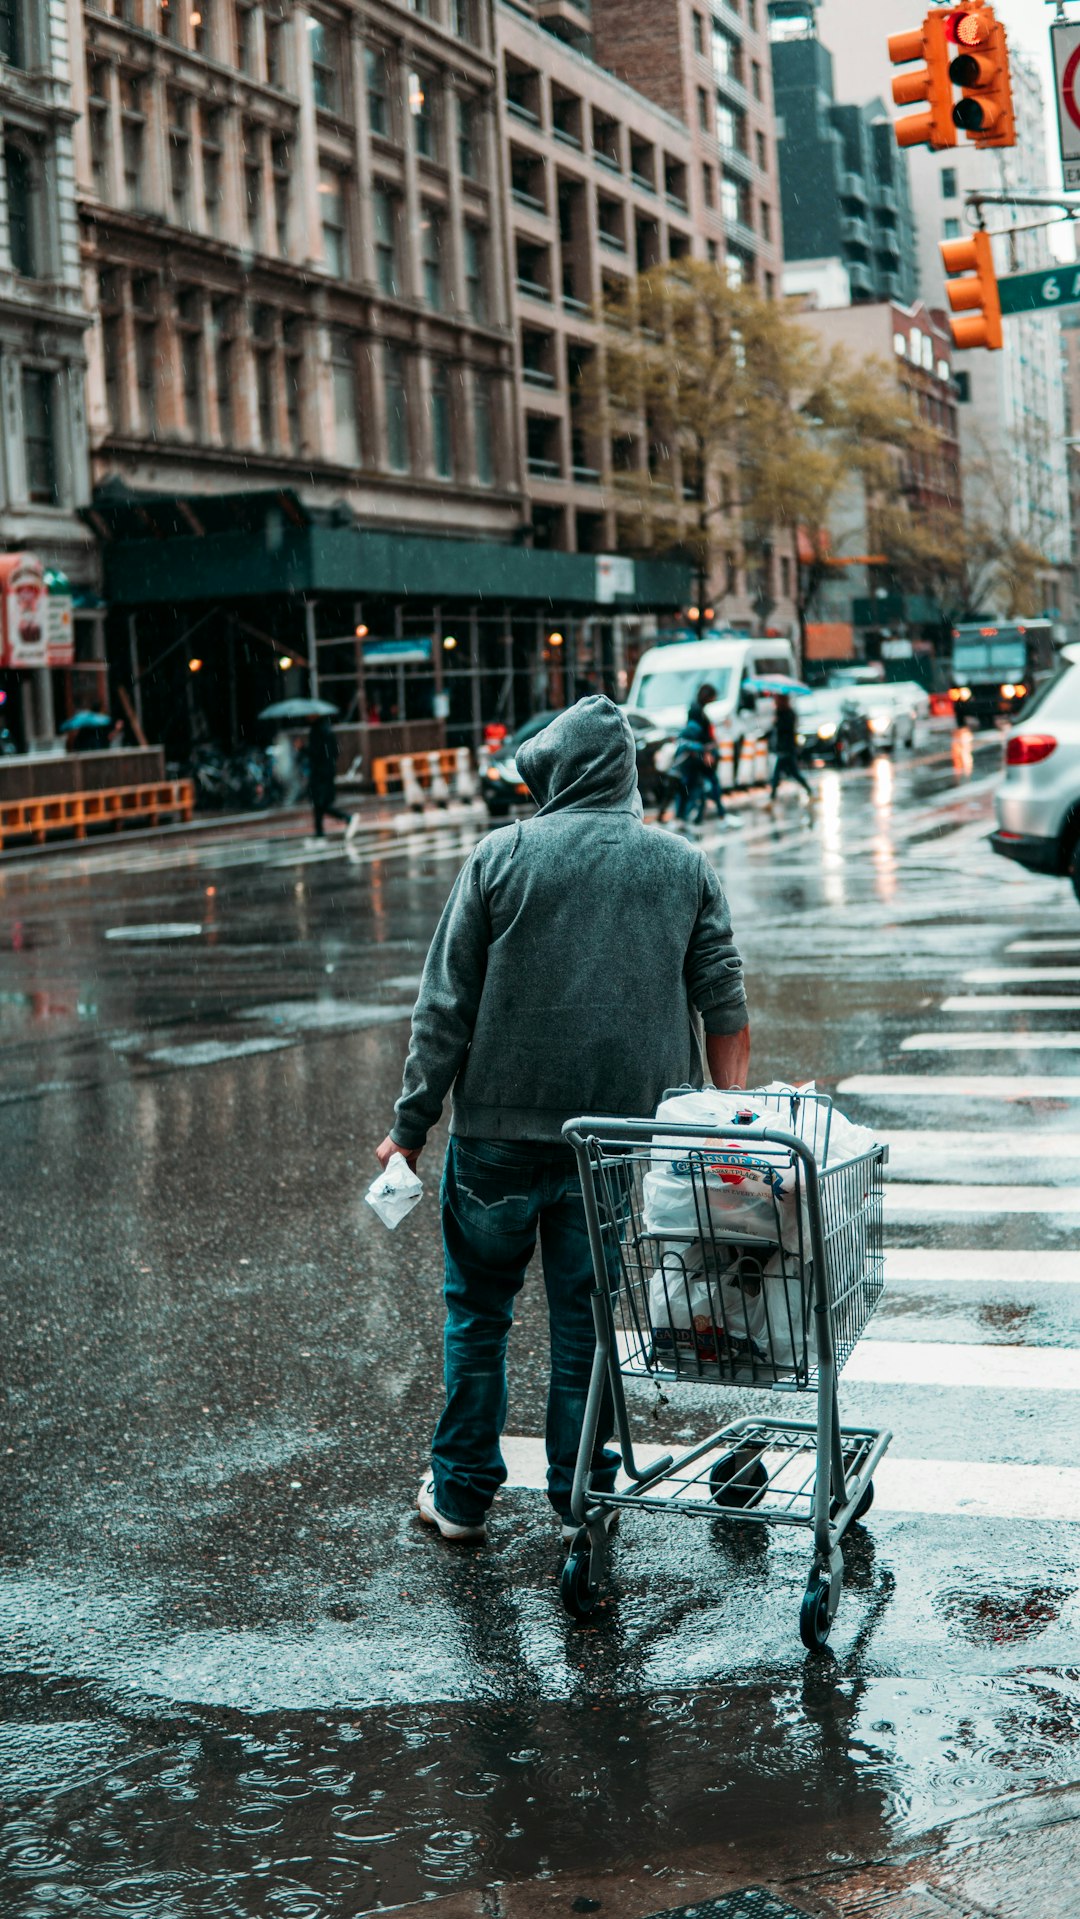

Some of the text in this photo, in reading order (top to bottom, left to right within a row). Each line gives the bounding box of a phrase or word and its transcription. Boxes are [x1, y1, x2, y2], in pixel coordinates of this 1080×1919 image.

[1041, 275, 1061, 301] 6
[728, 1155, 748, 1165] OF
[655, 1329, 705, 1345] GARDN
